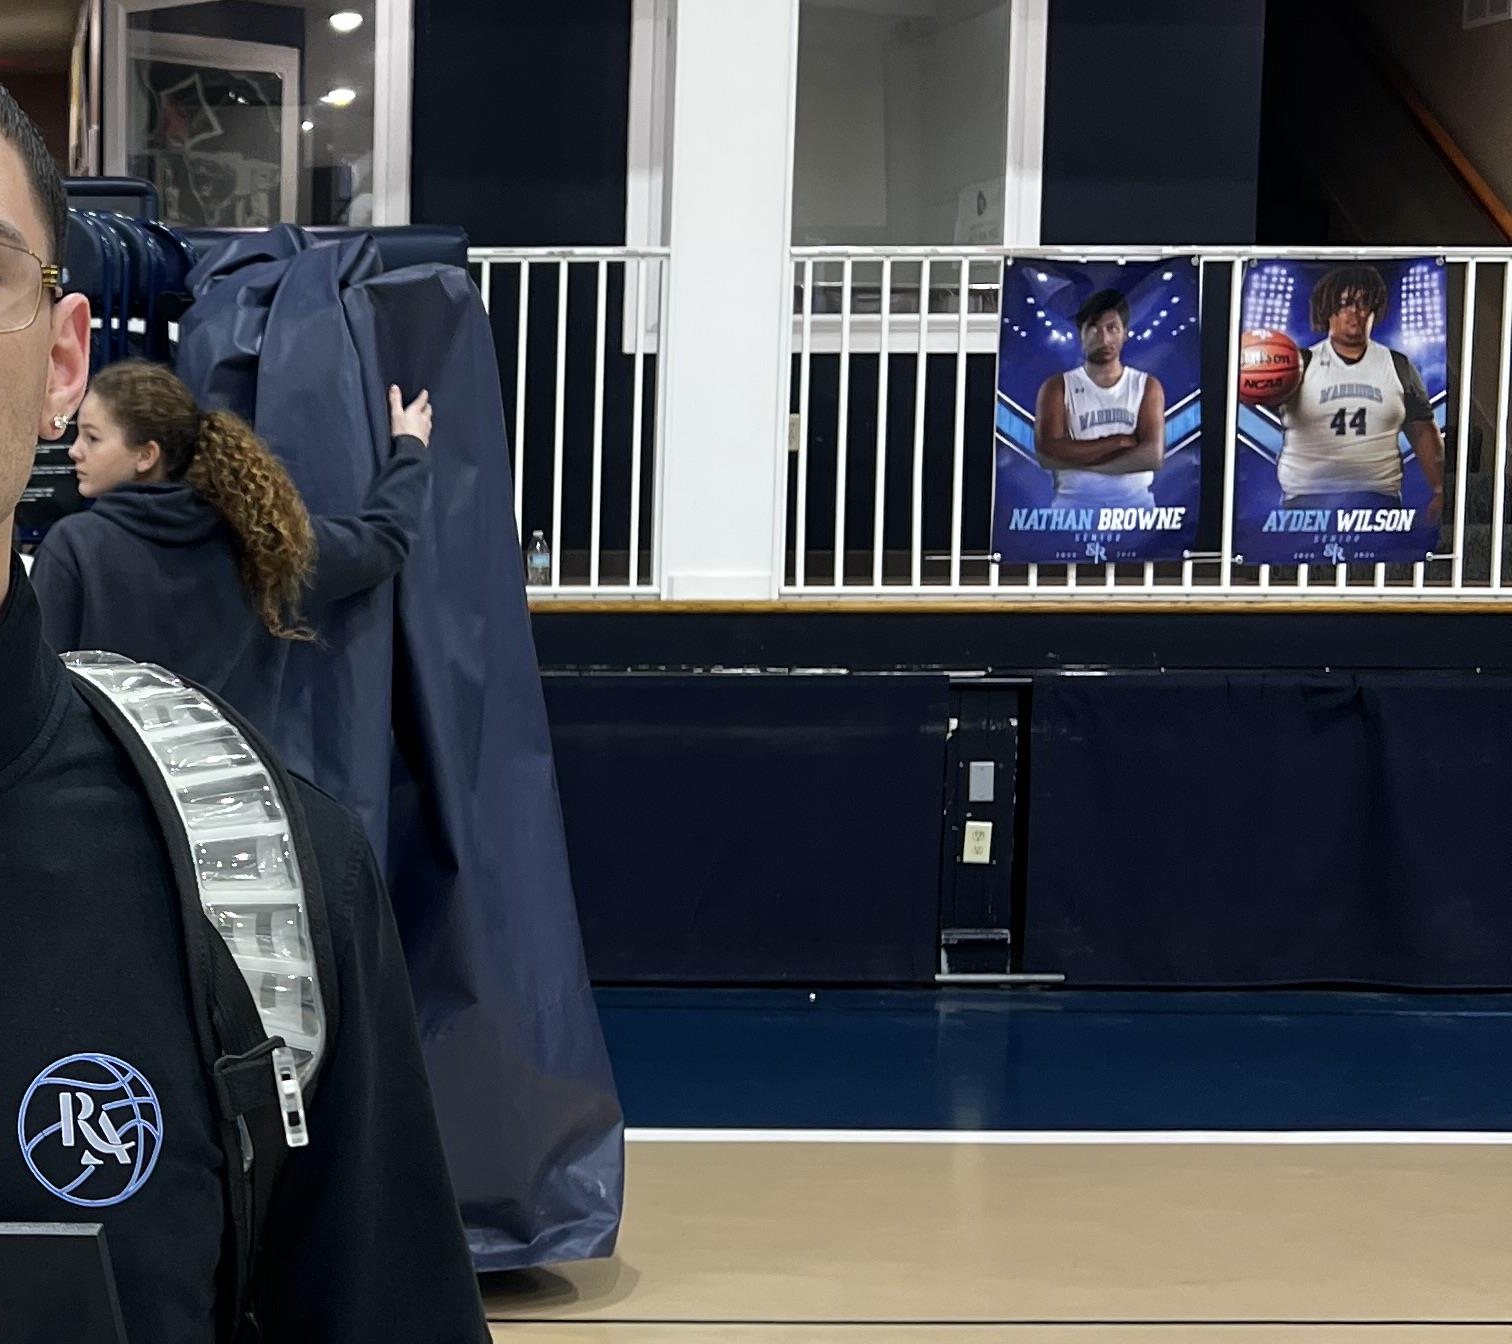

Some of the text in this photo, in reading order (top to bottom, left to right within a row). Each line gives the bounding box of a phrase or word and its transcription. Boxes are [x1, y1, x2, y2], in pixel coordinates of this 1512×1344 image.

[1330, 407, 1368, 436] 44
[1008, 507, 1186, 531] NATHAN BROWNE
[1262, 508, 1417, 533] AYDEN WILSON
